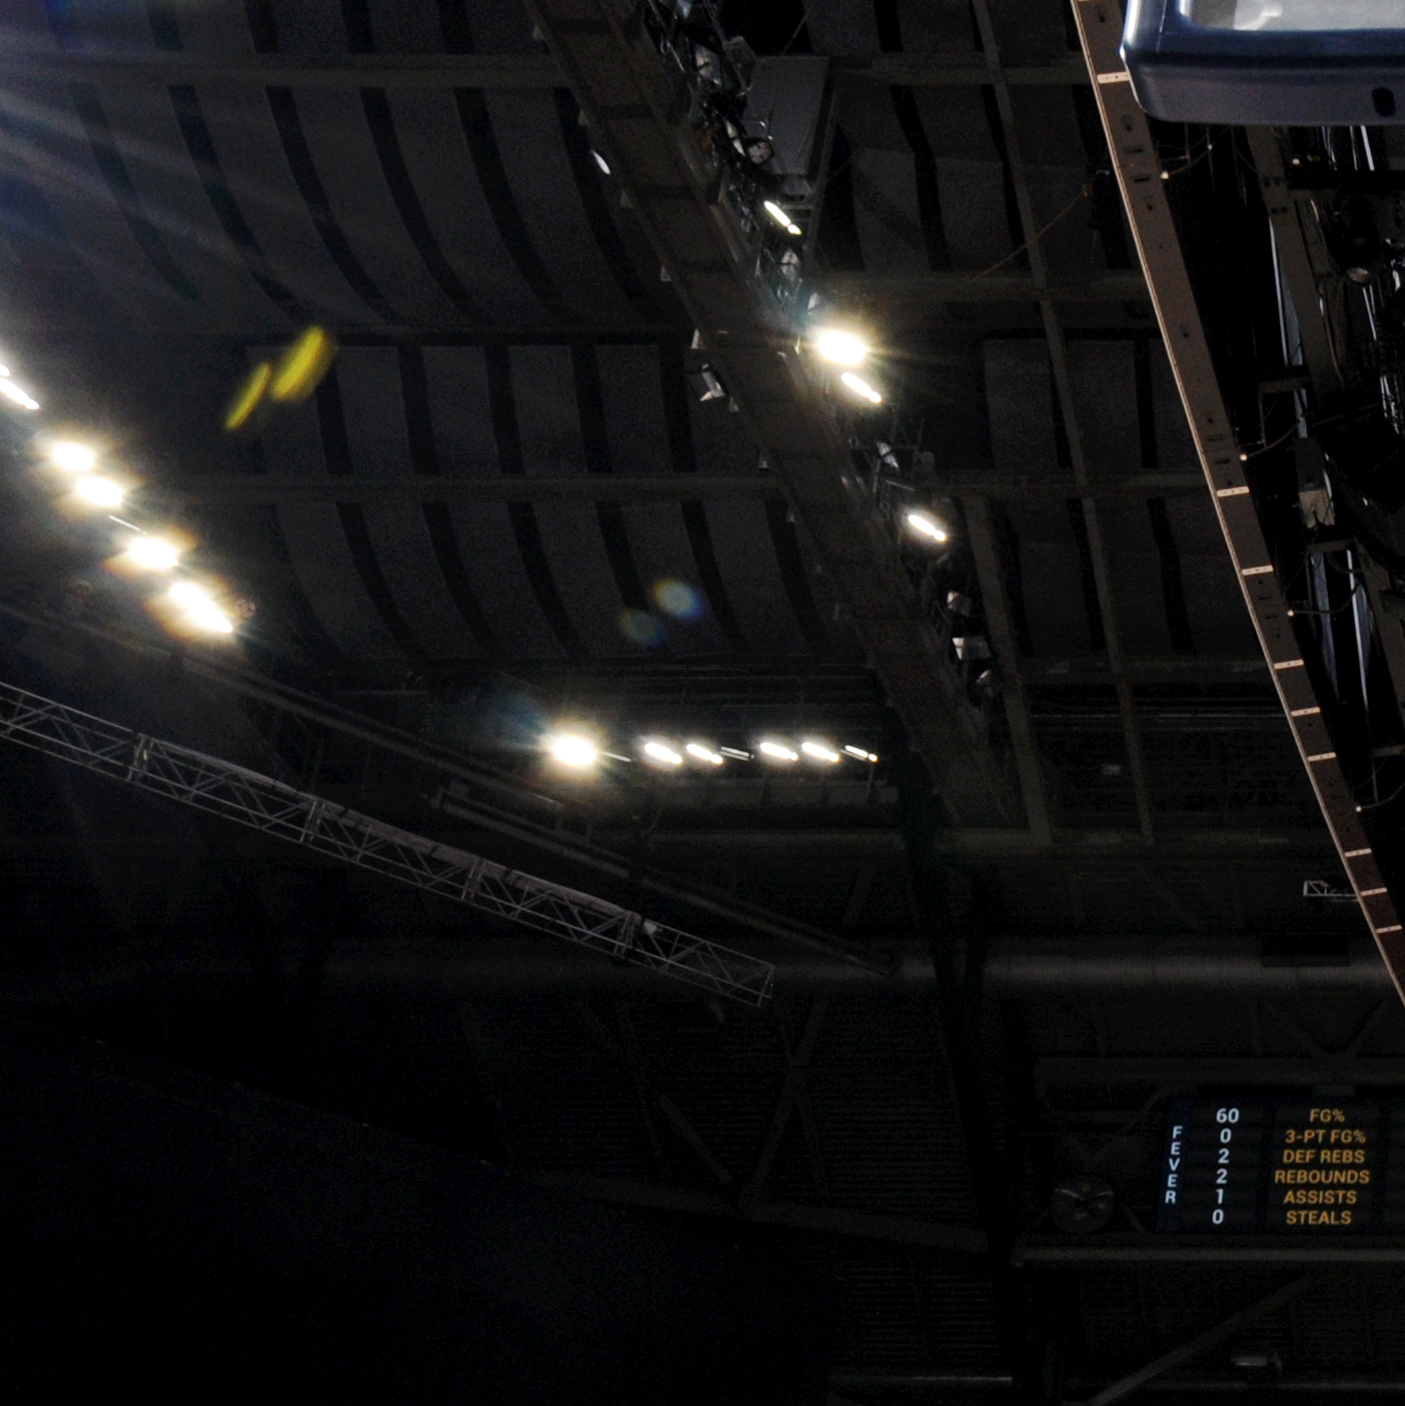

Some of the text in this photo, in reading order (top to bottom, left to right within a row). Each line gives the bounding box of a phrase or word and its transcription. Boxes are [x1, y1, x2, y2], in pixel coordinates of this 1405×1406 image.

[1216, 1108, 1239, 1123] 60
[1310, 1108, 1345, 1123] FG%
[1220, 1128, 1231, 1143] 0
[1285, 1129, 1324, 1144] 3-PT
[1330, 1129, 1366, 1144] FG%
[1218, 1148, 1230, 1163] 2
[1283, 1149, 1315, 1164] DEF
[1320, 1149, 1365, 1164] REBS
[1164, 1125, 1183, 1204] FEVER
[1216, 1169, 1228, 1184] 2
[1274, 1169, 1370, 1184] REBOUNDS
[1216, 1189, 1224, 1204] 1
[1283, 1190, 1357, 1205] ASSISTS
[1212, 1209, 1224, 1224] 0
[1286, 1211, 1351, 1225] STEALS
